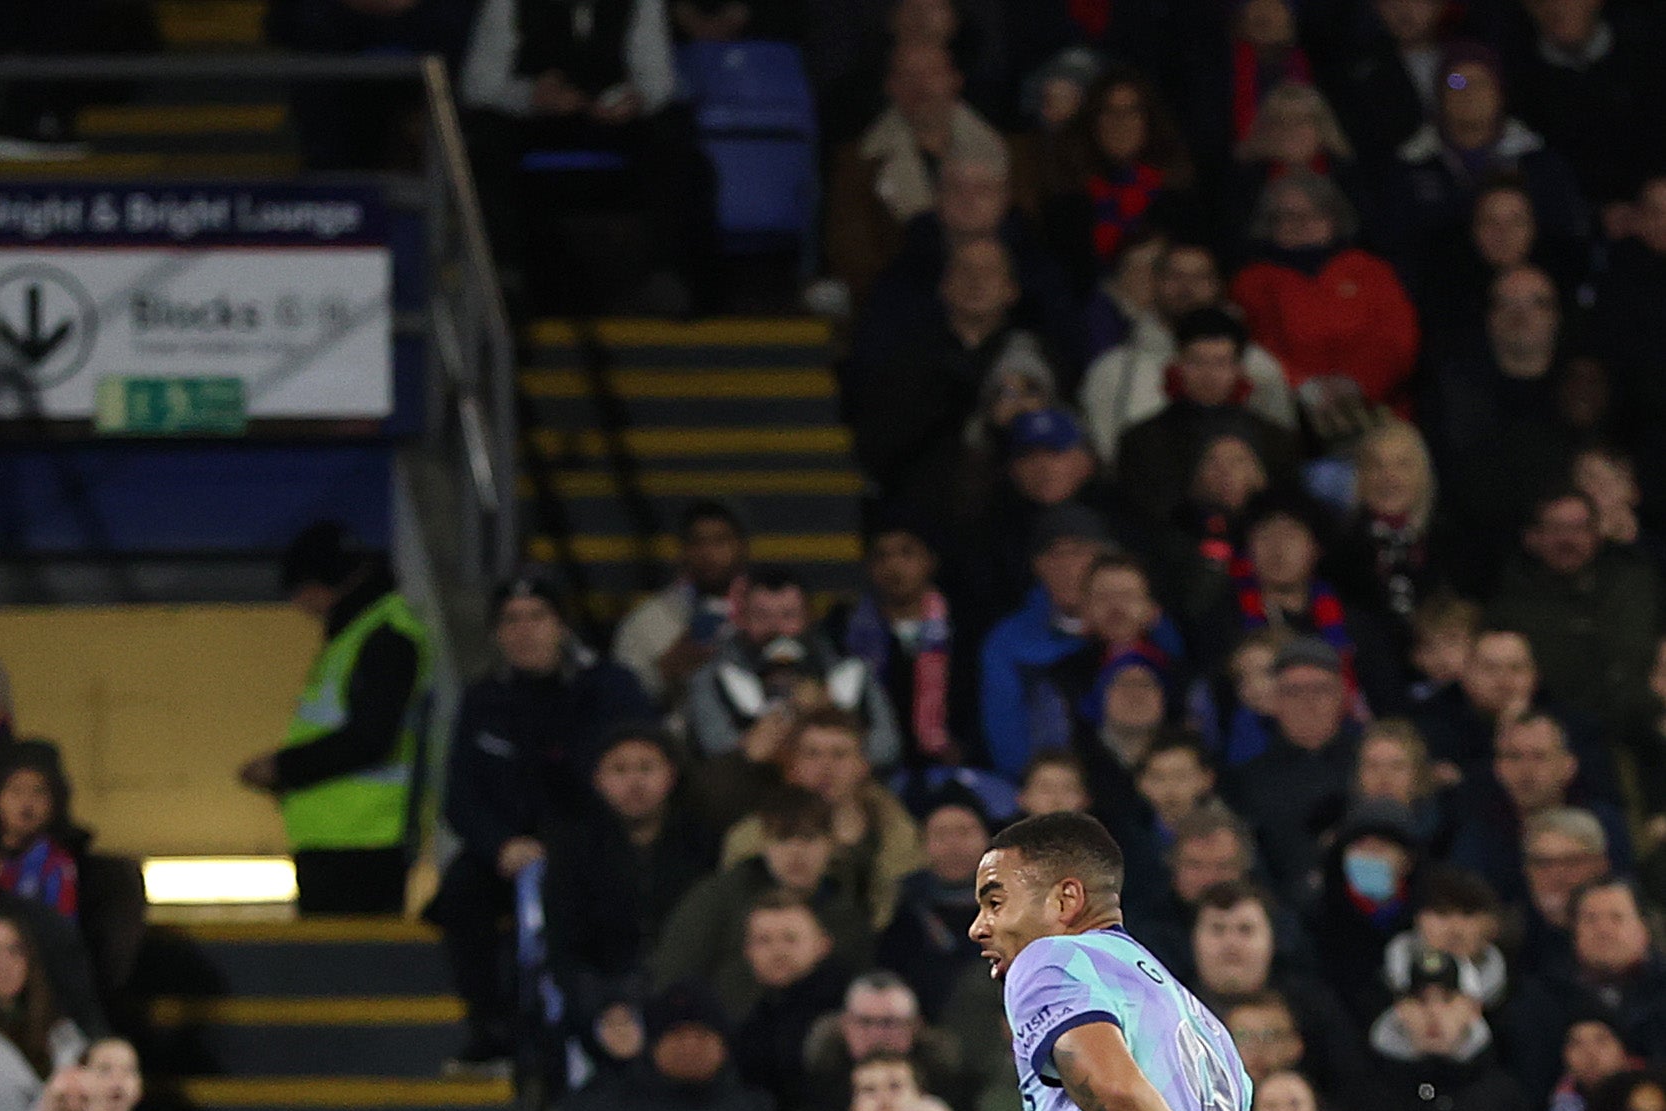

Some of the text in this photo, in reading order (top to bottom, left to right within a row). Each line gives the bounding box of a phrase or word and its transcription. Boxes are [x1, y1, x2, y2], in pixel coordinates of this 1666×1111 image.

[89, 193, 120, 233] &
[124, 193, 231, 239] Bright
[236, 193, 365, 239] Lounge
[1016, 1004, 1053, 1039] VISIT
